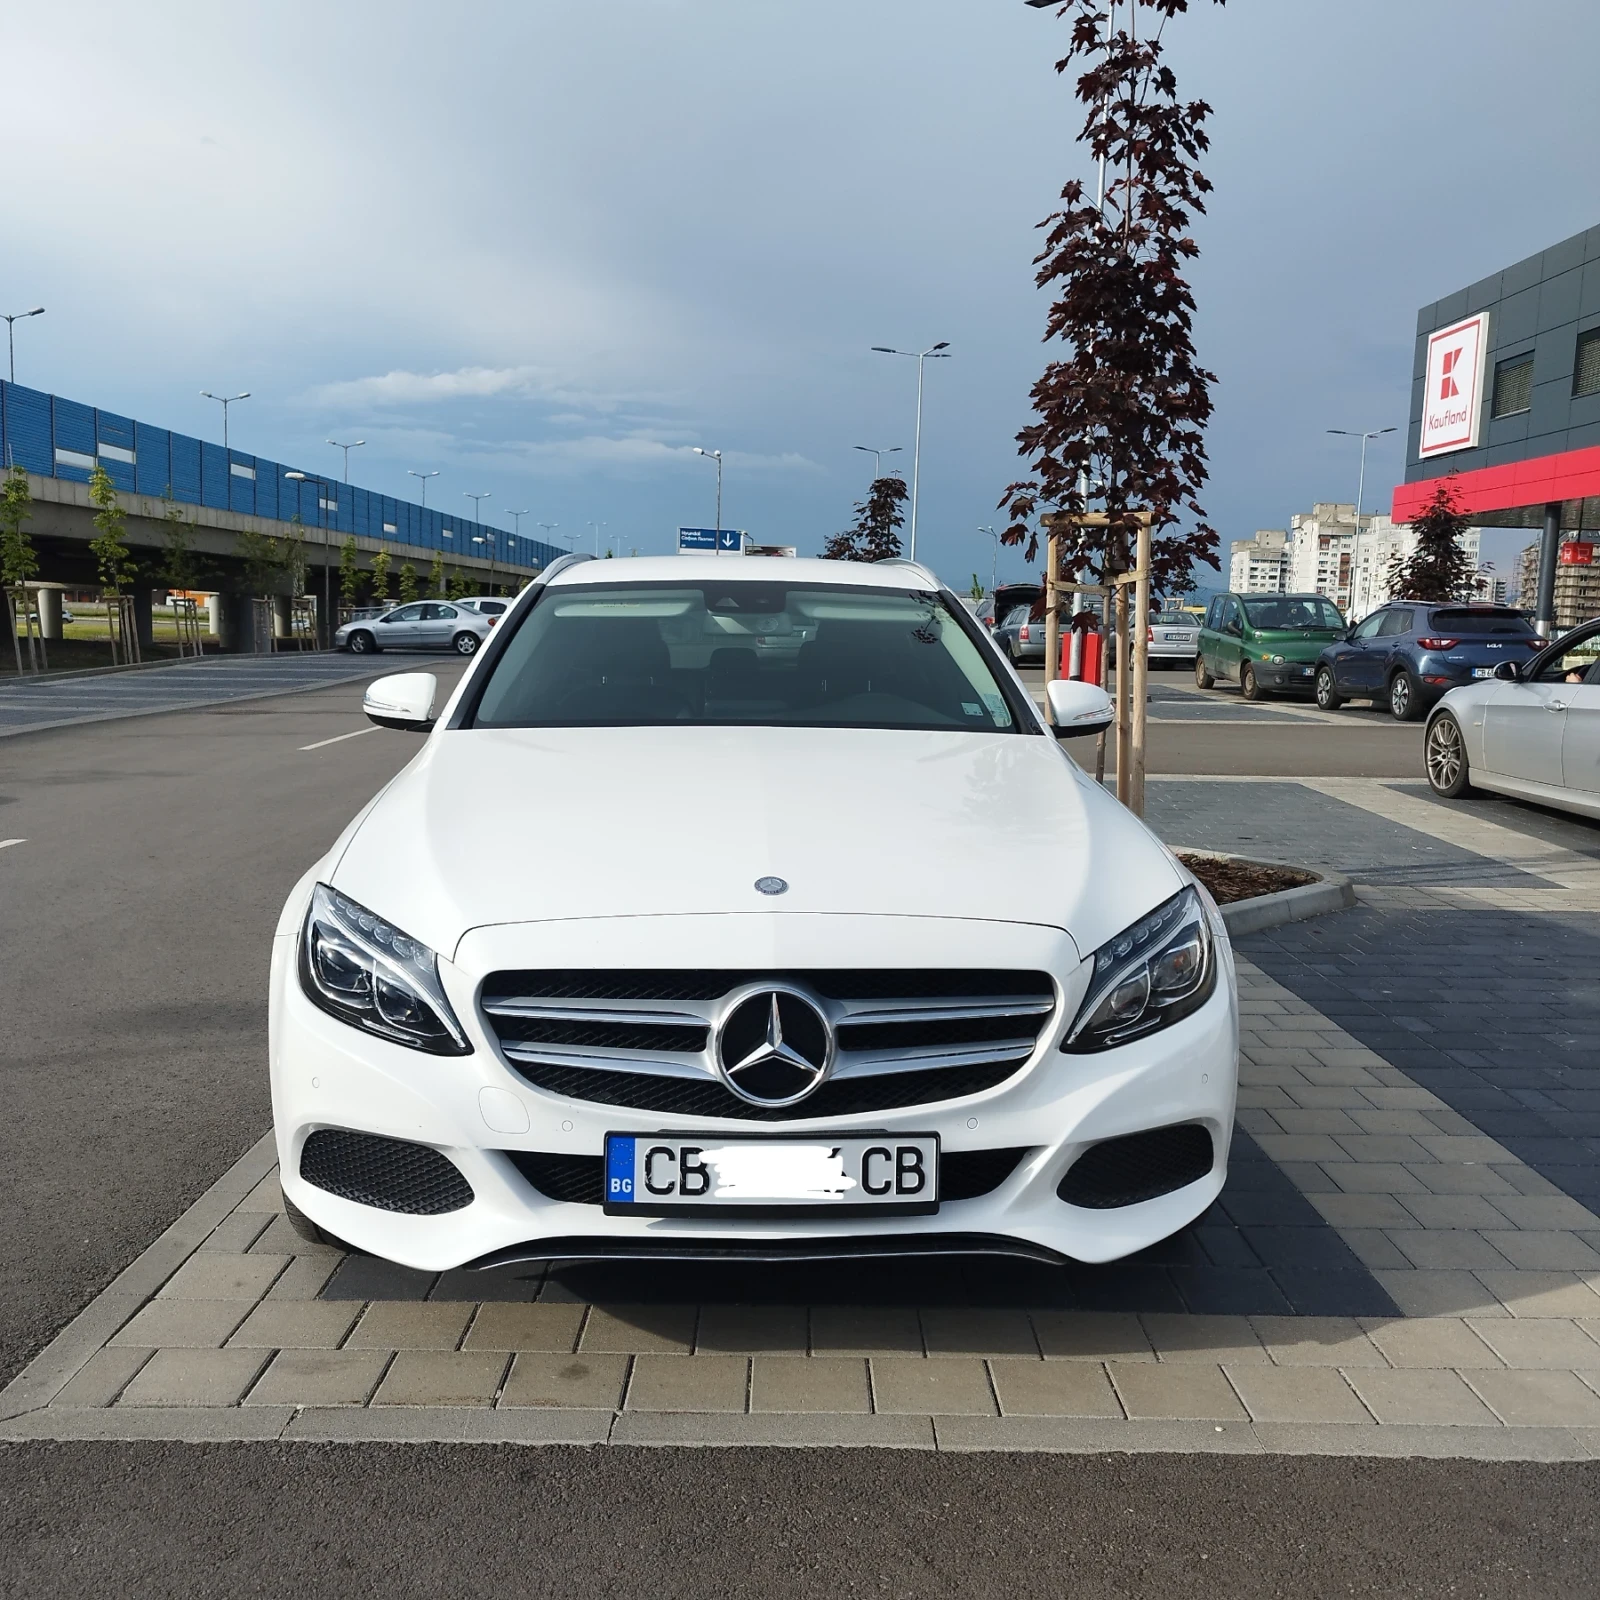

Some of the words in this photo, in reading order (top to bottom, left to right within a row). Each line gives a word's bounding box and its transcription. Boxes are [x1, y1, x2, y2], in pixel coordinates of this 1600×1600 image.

[1428, 404, 1467, 431] Kaufland
[861, 1146, 926, 1196] CB
[611, 1178, 632, 1193] BG
